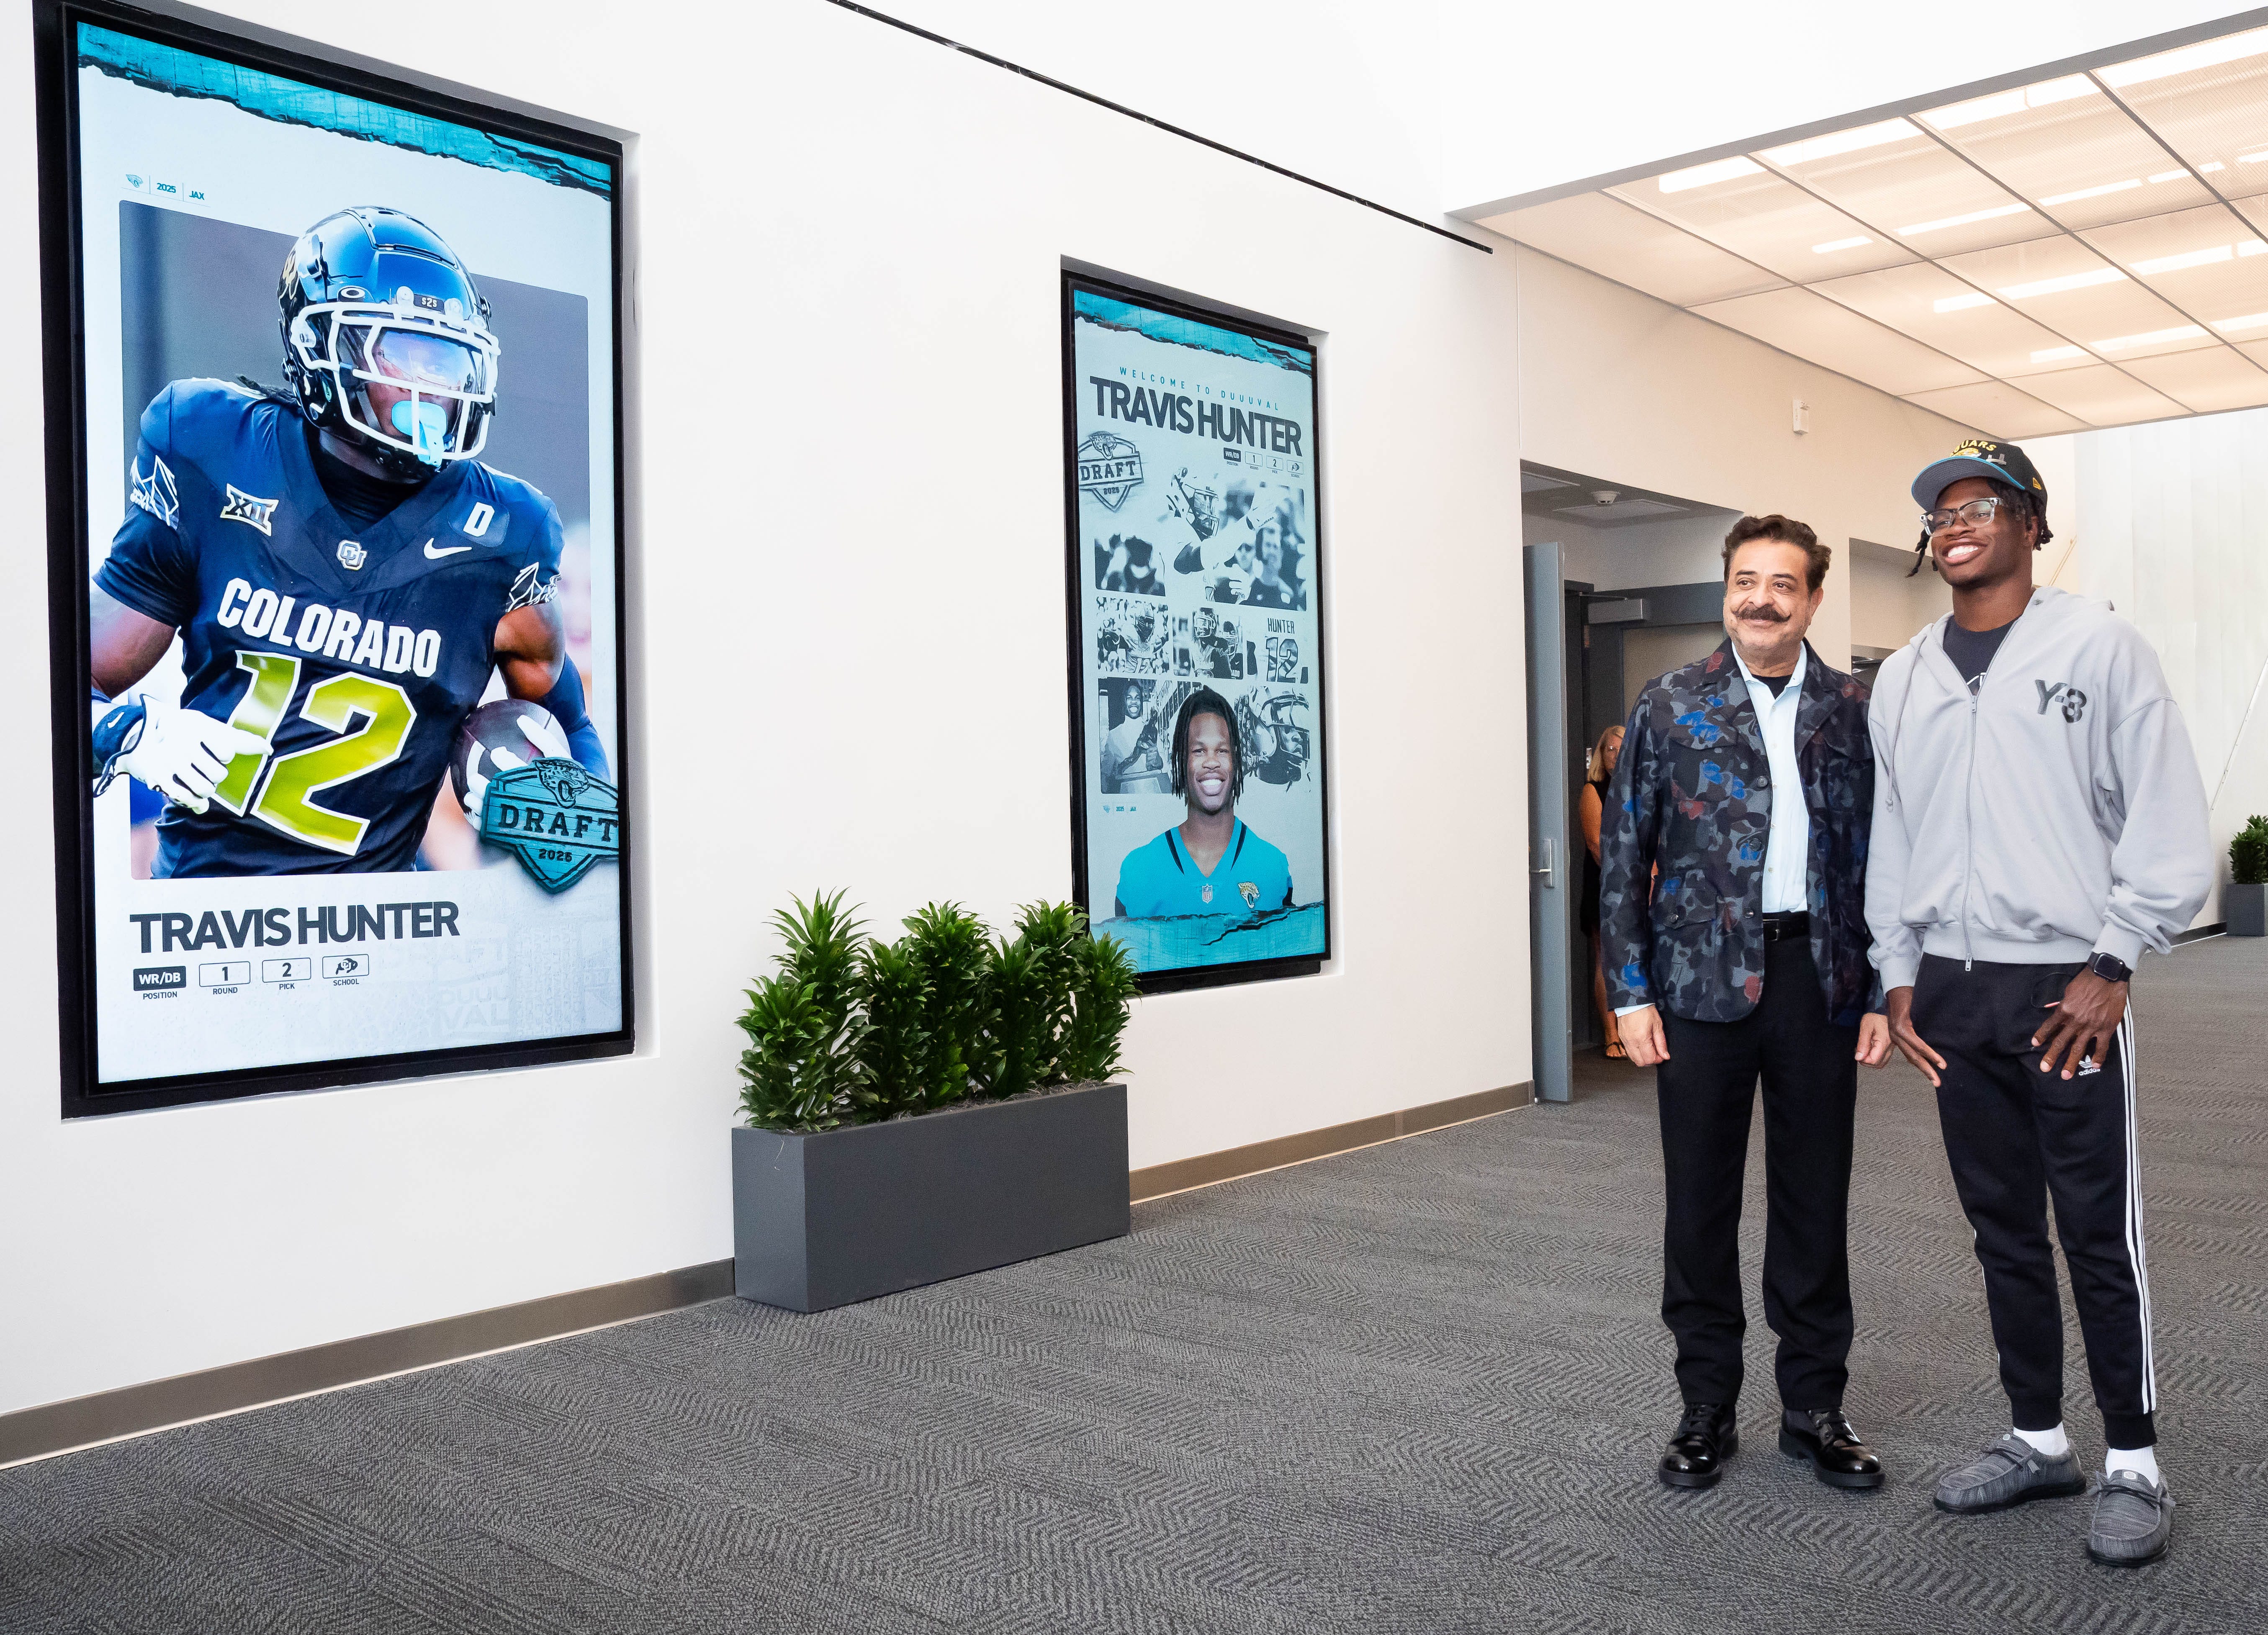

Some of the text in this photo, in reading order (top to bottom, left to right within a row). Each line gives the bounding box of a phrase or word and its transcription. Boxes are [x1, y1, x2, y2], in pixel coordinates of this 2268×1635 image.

[157, 182, 176, 193] 2025
[189, 190, 205, 200] JAX
[422, 297, 437, 308] S2S
[1120, 367, 1278, 411] WELCOME TO DUUUVAL
[1090, 375, 1303, 457] TRAVIS HUNTER
[1225, 451, 1239, 459] WR/DB
[1252, 455, 1255, 463] 1
[1273, 459, 1277, 467] 2
[1080, 460, 1136, 481] DRAFT
[217, 578, 441, 677] COLORADO
[1267, 618, 1295, 634] HUNTER
[1265, 637, 1298, 683] 12
[2035, 679, 2087, 724] Y-3
[213, 649, 417, 856] 12
[498, 803, 618, 842] DRAFT
[538, 848, 572, 862] 2025
[130, 901, 460, 953] TRAVIS HUNTER
[222, 966, 229, 981] 1
[282, 963, 292, 977] 2
[139, 971, 181, 985] WR/DB
[143, 991, 177, 1000] POSITION
[2078, 1068, 2101, 1076] adidas
